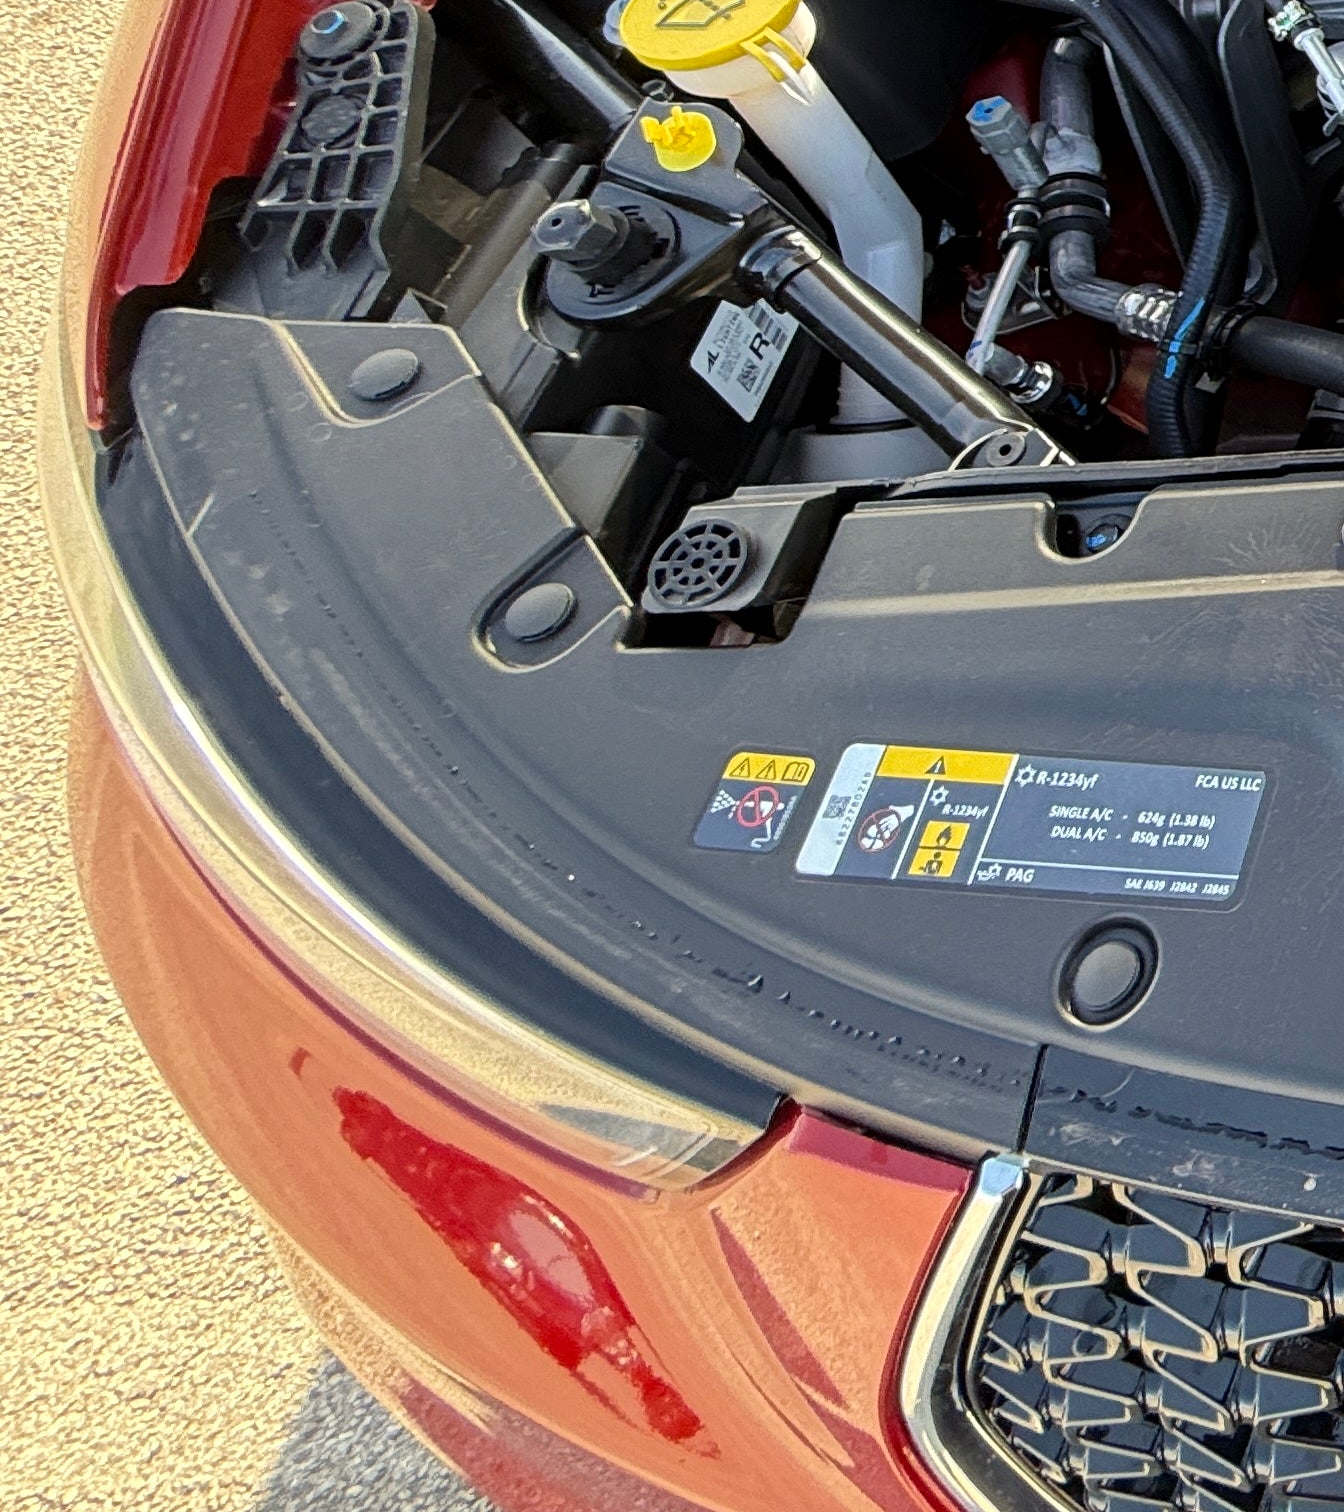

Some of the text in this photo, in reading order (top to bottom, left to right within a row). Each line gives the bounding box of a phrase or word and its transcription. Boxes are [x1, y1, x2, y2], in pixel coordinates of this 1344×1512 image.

[749, 332, 771, 360] R
[1036, 771, 1099, 791] R-1234yf
[1195, 774, 1262, 792] FCA US LLC
[942, 803, 990, 819] R-1234yf
[1049, 805, 1090, 819] SINGLE
[1090, 807, 1114, 823] A/C
[1137, 811, 1166, 828] 624g
[1169, 813, 1199, 828] (1.38
[1199, 815, 1216, 830] lb)
[1050, 825, 1082, 840] DUAL
[1083, 827, 1108, 843] A/C
[1131, 831, 1160, 848] 850g
[1162, 833, 1193, 848] (1.87
[1193, 834, 1210, 850] lb)
[1005, 867, 1035, 883] PAG
[1124, 878, 1143, 890] SAE
[1143, 879, 1166, 892] J639
[1201, 883, 1230, 896] J2845
